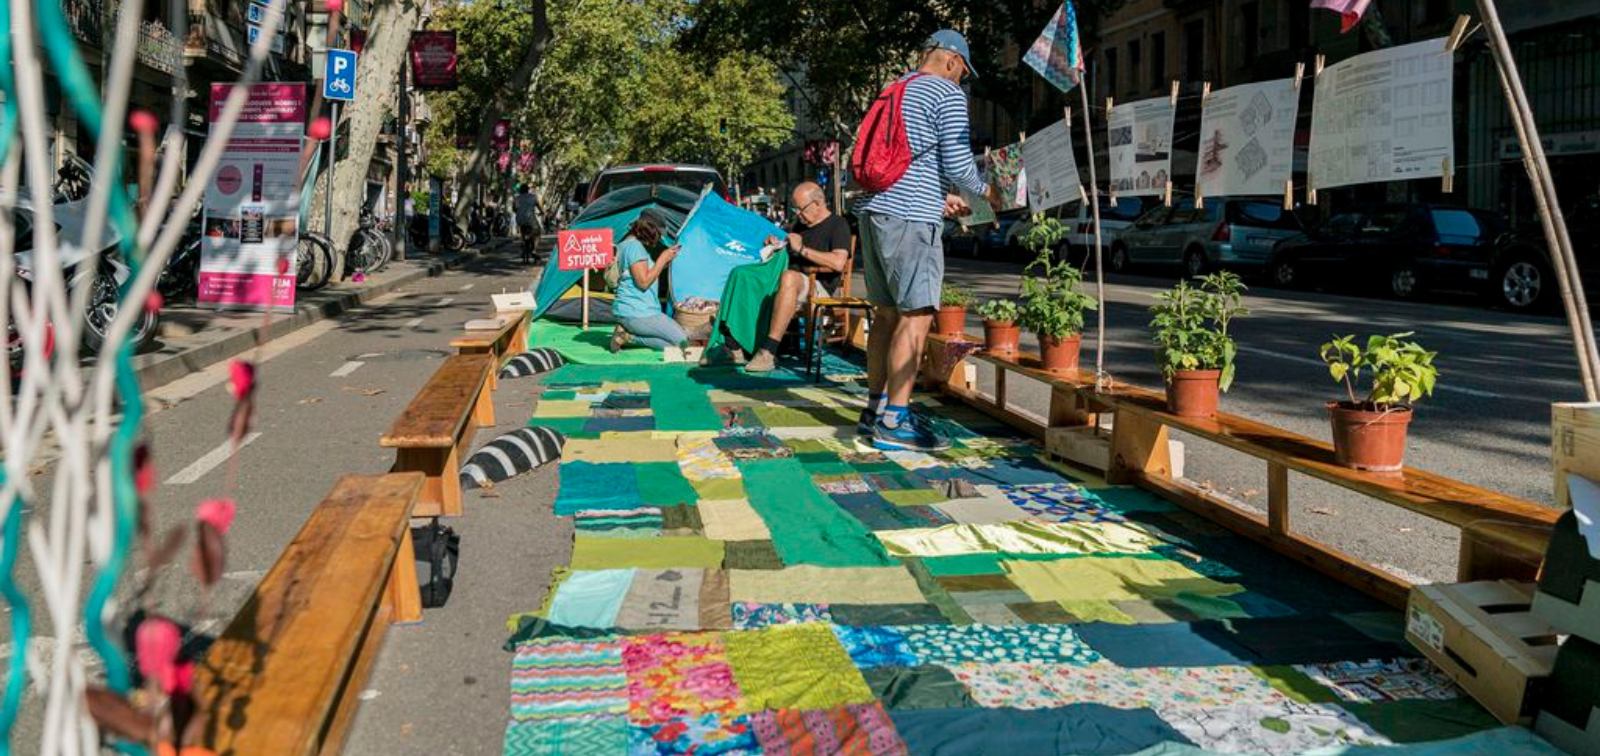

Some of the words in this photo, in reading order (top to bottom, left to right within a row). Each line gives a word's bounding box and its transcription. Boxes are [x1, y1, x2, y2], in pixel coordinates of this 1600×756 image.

[334, 57, 348, 75] P
[582, 243, 599, 253] FOR
[568, 252, 608, 267] STUDENT
